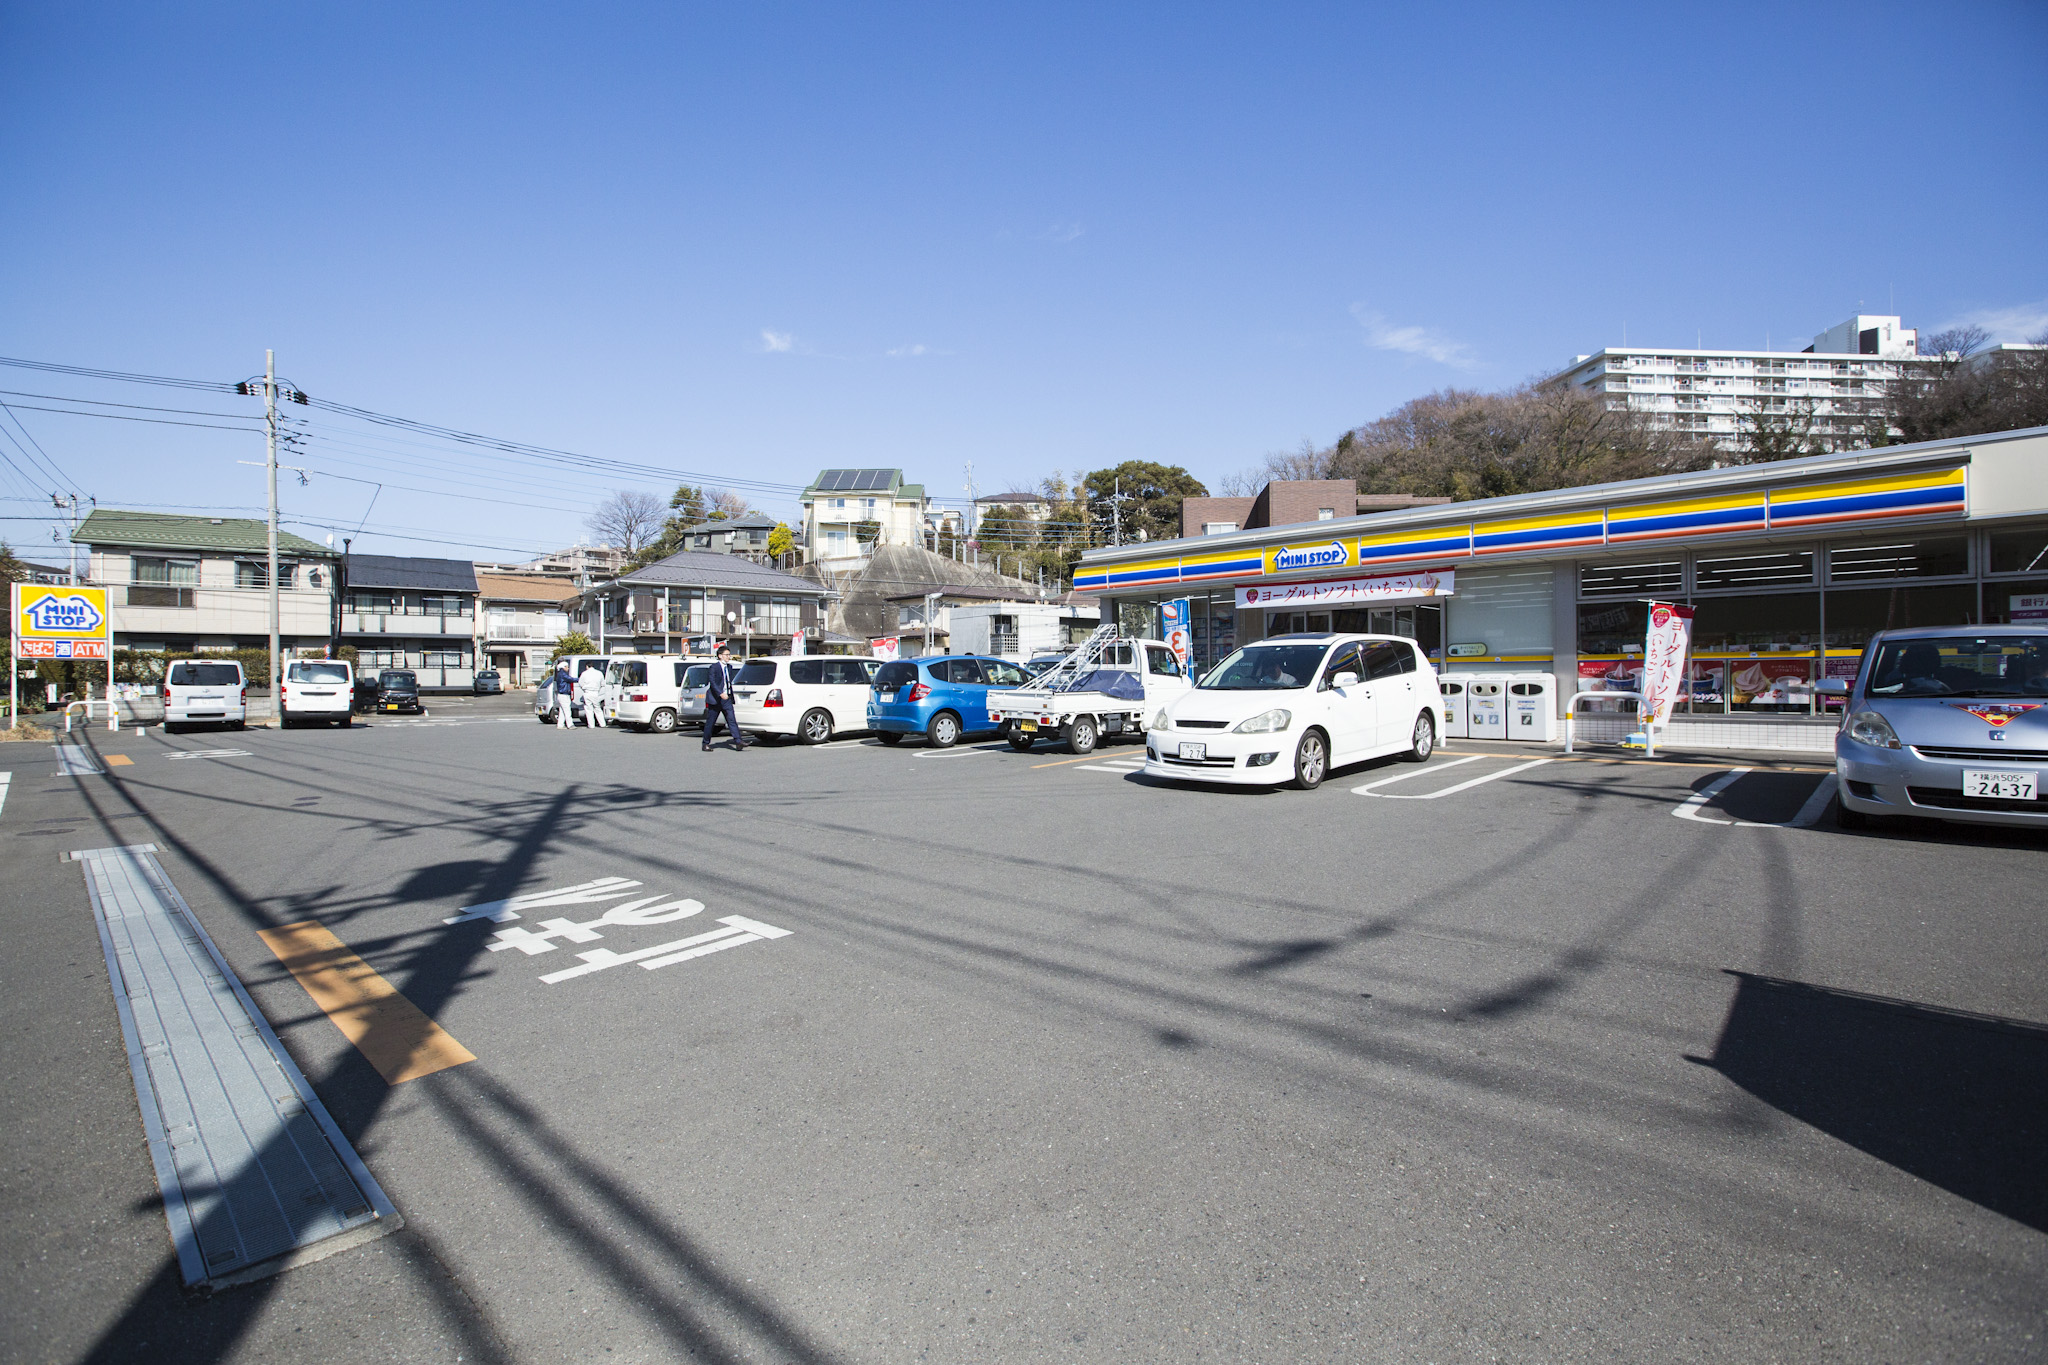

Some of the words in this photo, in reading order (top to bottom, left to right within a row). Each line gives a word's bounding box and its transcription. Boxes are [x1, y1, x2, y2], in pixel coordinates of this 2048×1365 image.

[1280, 554, 1307, 568] MINI
[1309, 549, 1340, 564] STOP
[2020, 597, 2048, 607] 銀行
[45, 605, 84, 615] MINI
[42, 615, 86, 626] STOP
[22, 642, 54, 655] たばこ
[56, 642, 71, 656] 酒
[74, 644, 104, 656] ATM
[1978, 782, 2032, 798] 24-37
[442, 876, 795, 985] 止まれ
